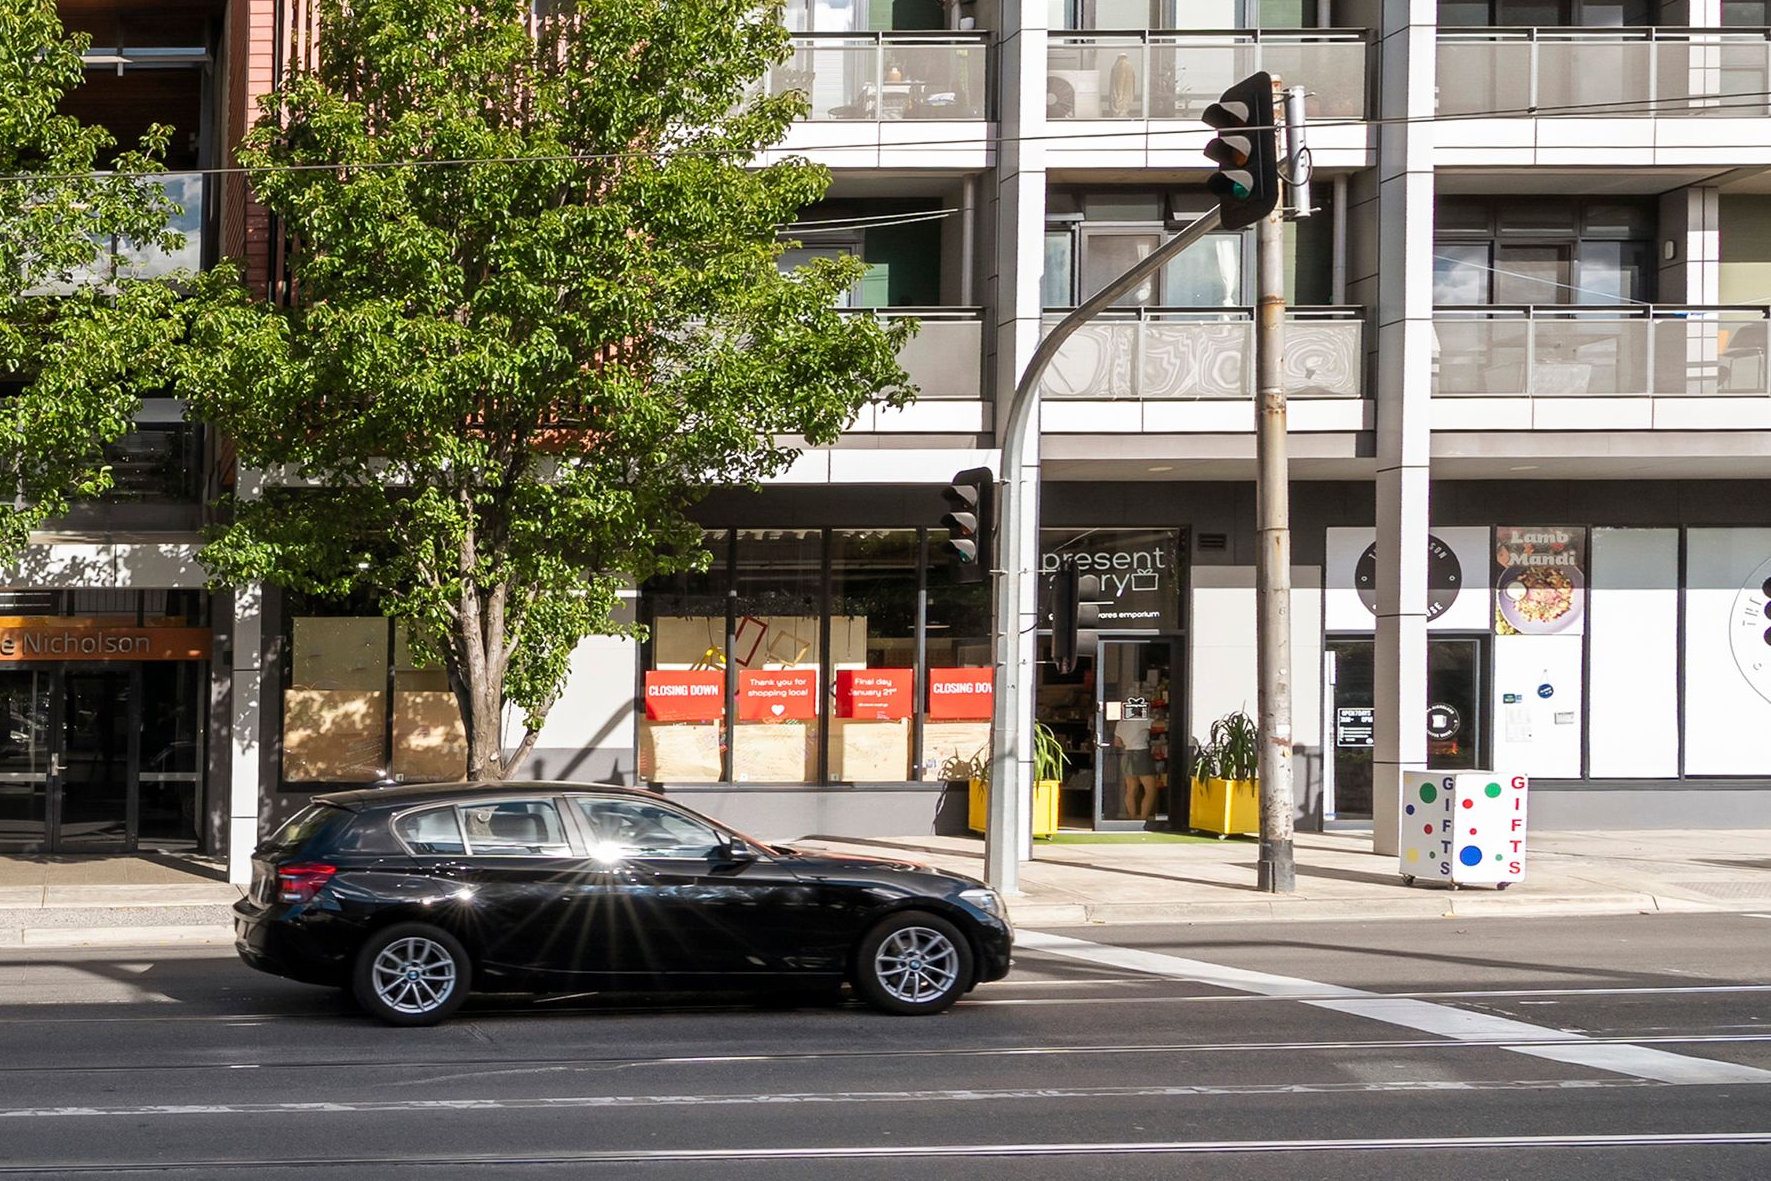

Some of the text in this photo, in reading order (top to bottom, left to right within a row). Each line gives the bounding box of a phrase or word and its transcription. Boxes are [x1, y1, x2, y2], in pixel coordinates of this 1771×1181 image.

[1511, 530, 1569, 543] Lamb
[1042, 547, 1166, 575] present
[1508, 550, 1576, 566] Mandi
[1118, 610, 1160, 619] emporium
[22, 631, 150, 655] Nicholson
[749, 678, 807, 688] Thank you for
[854, 678, 892, 687] Final day
[933, 682, 993, 694] CLOSING DO
[648, 684, 719, 697] CLOSING DOWN
[747, 689, 787, 698] shopping
[848, 688, 882, 698] January
[1440, 777, 1454, 875] GIFTS
[1509, 776, 1525, 874] GIFTS
